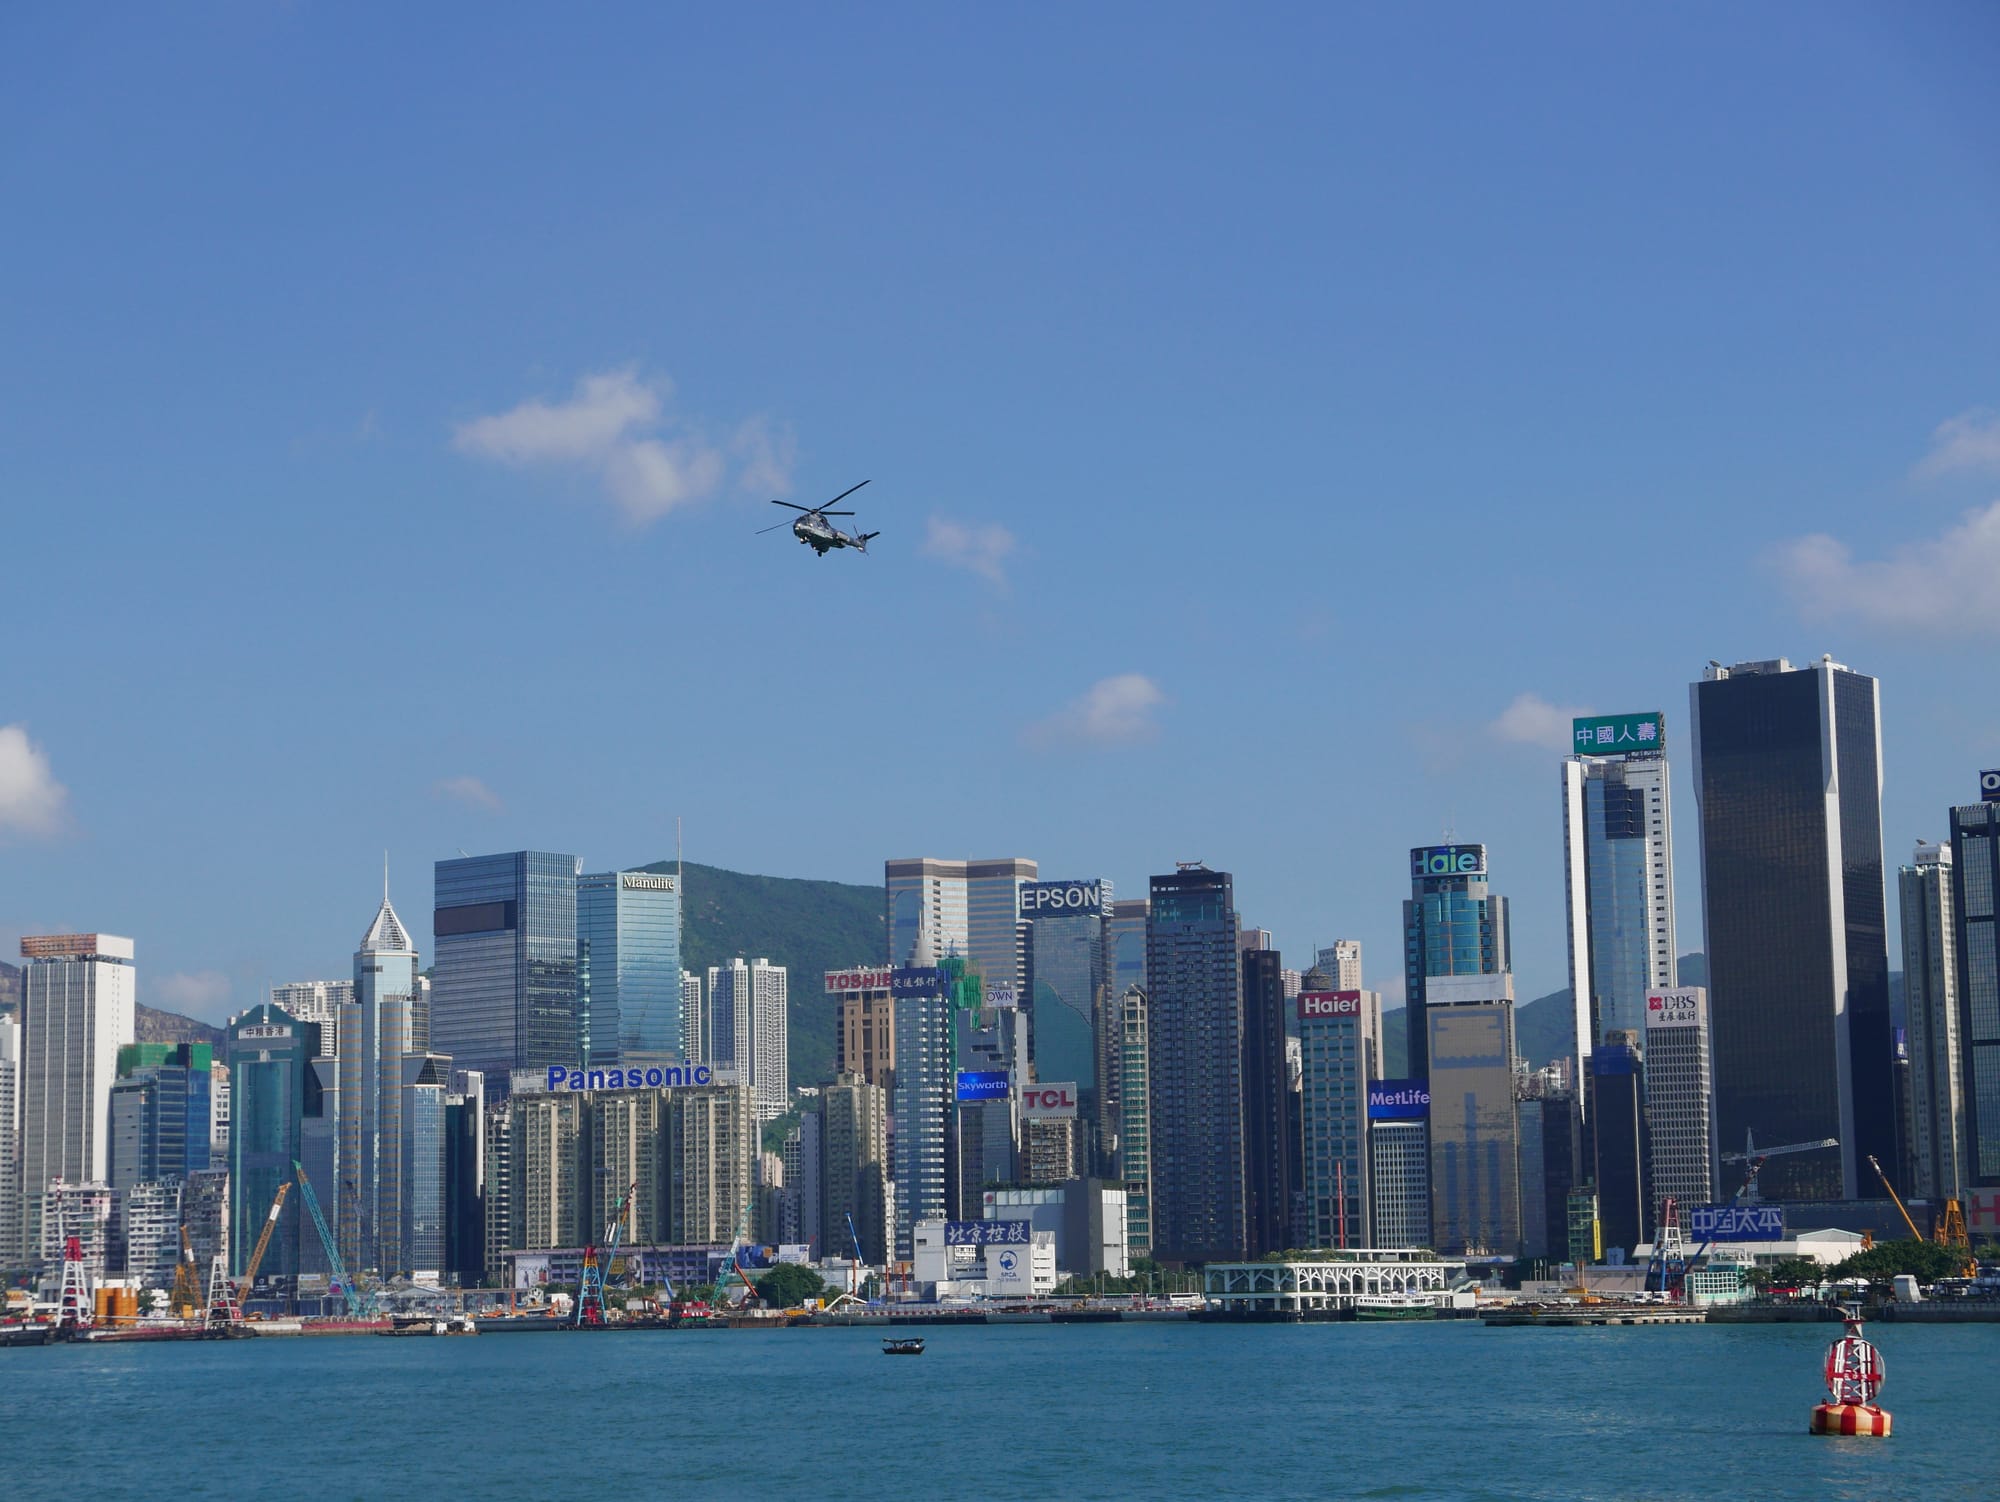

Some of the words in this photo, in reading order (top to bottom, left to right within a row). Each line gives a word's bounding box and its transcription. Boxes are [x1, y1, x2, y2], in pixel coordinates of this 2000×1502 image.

[1576, 722, 1657, 746] 中國人壽
[1411, 847, 1482, 876] Haie
[623, 875, 675, 890] Manulife
[1021, 886, 1099, 910] EPSON
[1304, 995, 1359, 1015] Haier
[1664, 995, 1696, 1010] DBS
[548, 1059, 712, 1091] Panasonic
[958, 1081, 1007, 1091] Skyworth
[1023, 1090, 1074, 1108] TCL
[1370, 1089, 1430, 1106] MetLife
[1691, 1207, 1782, 1234] 中国太平
[948, 1222, 1028, 1244] 北京控股
